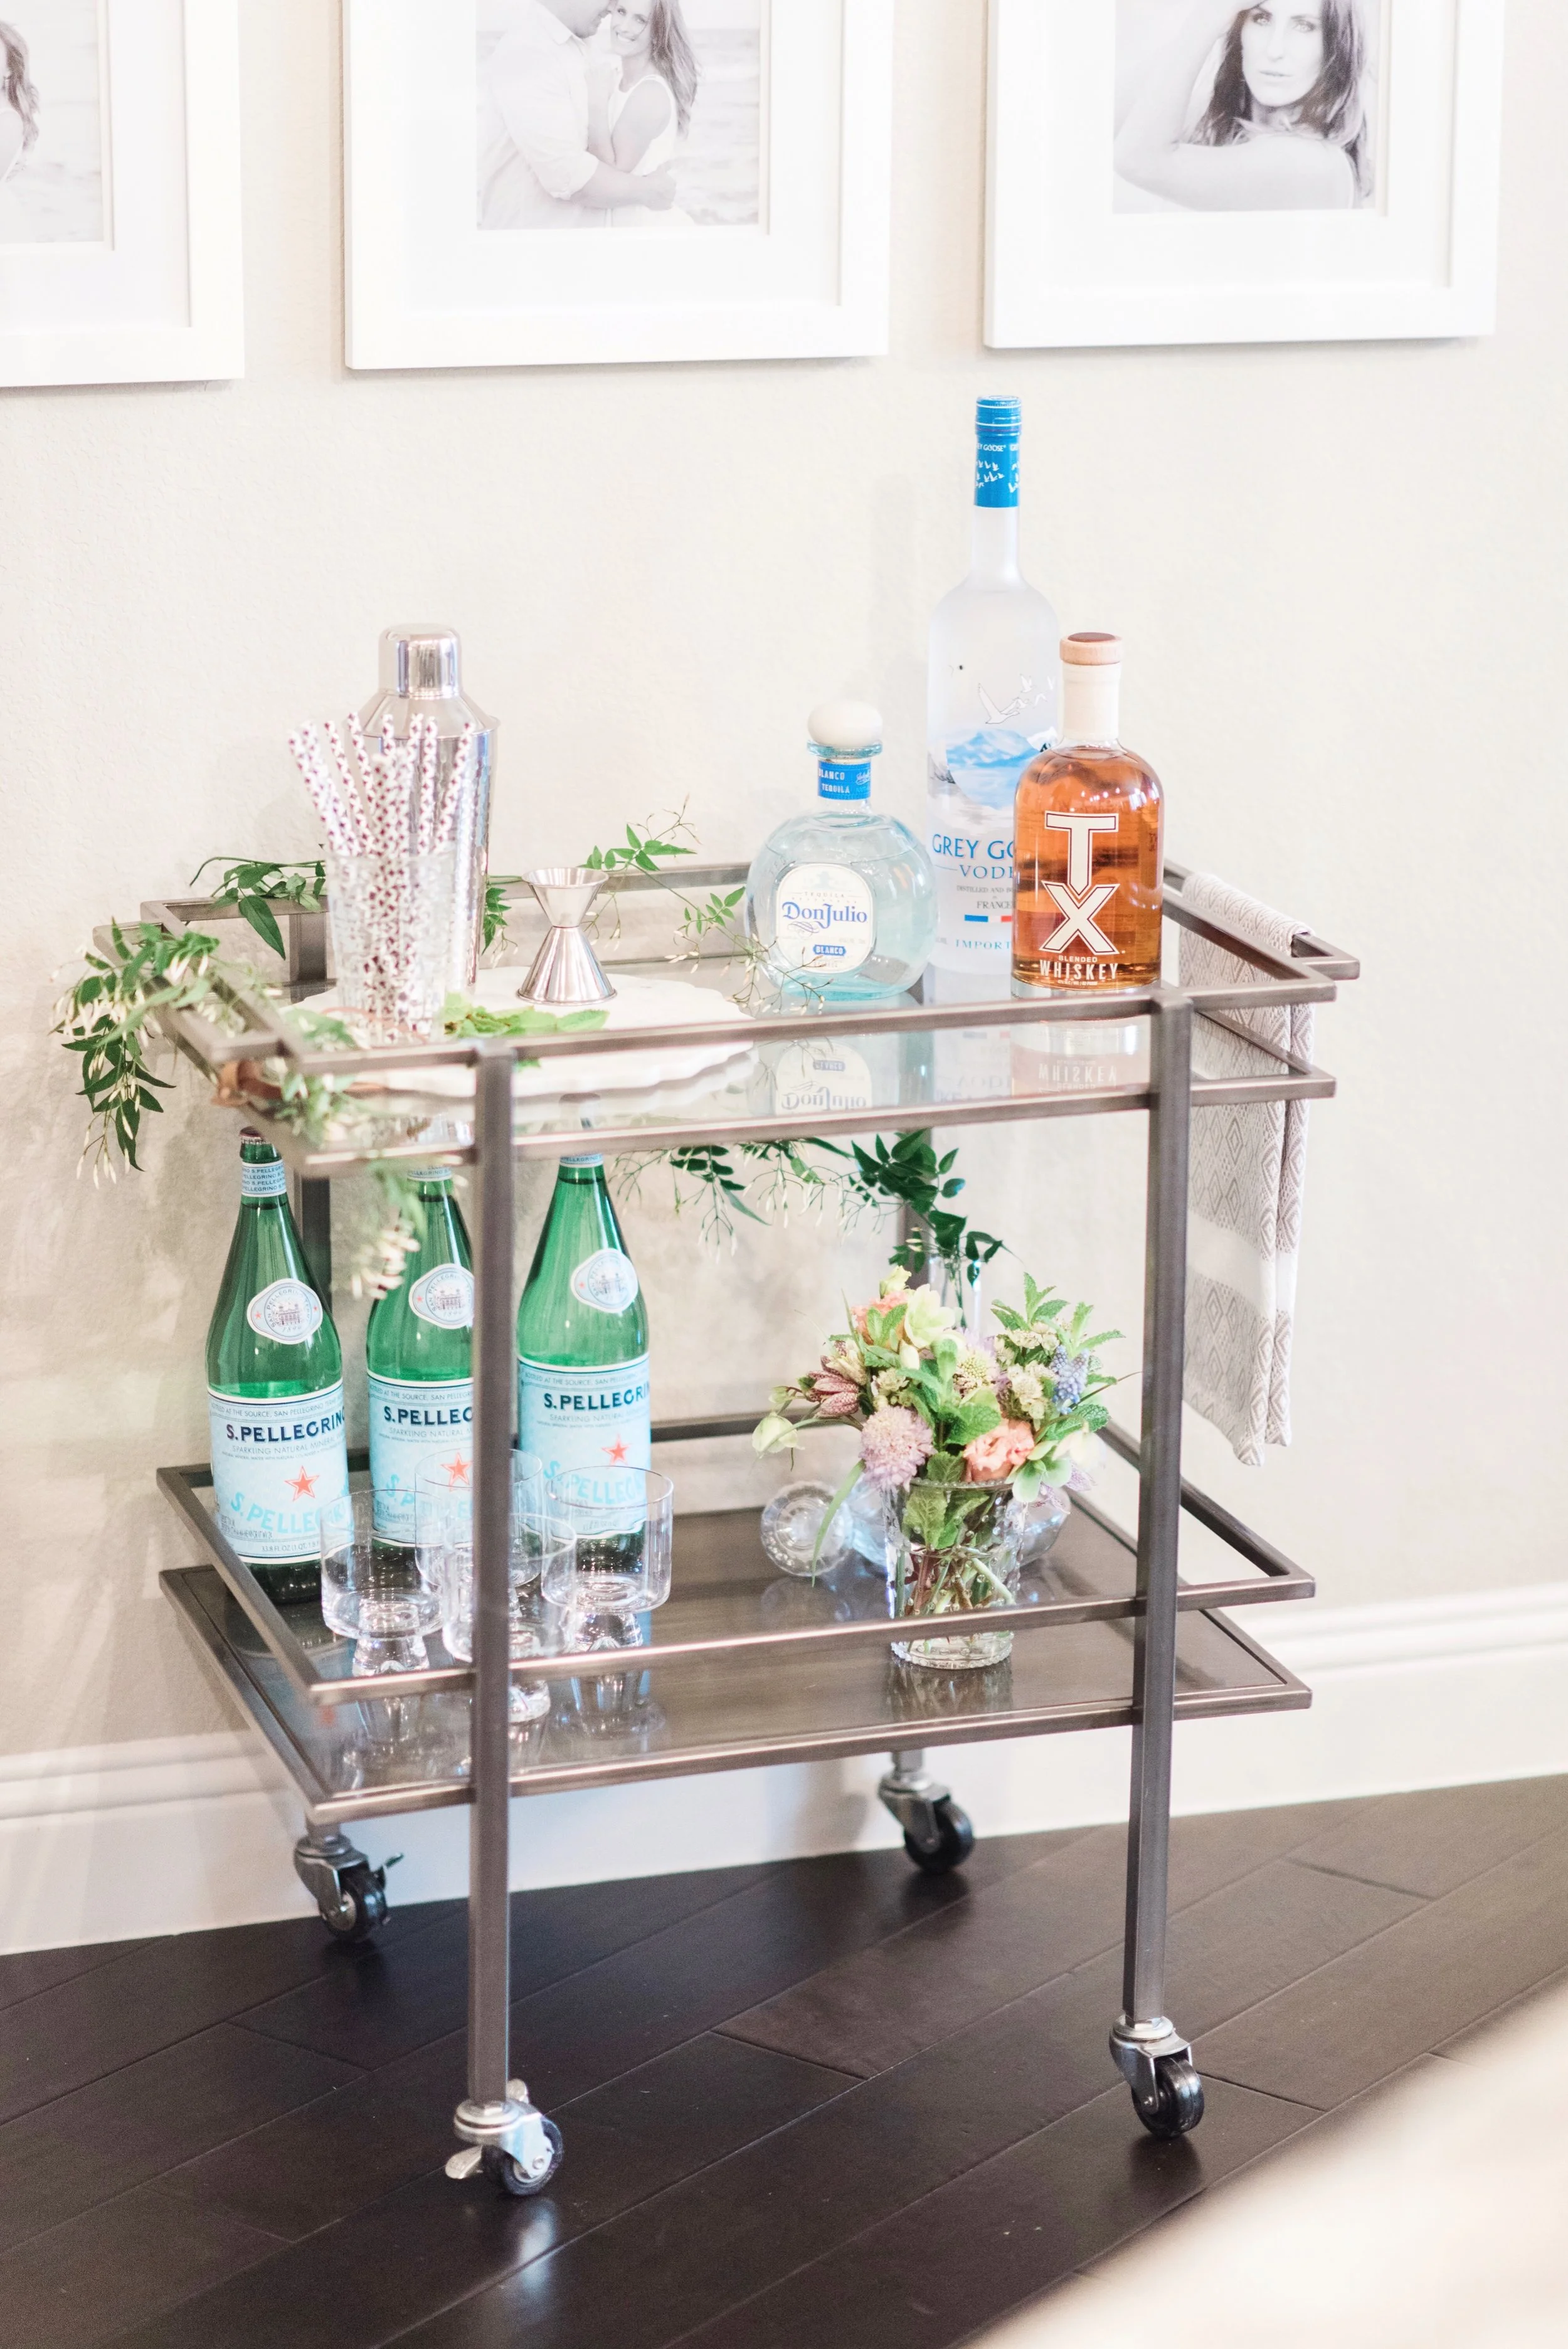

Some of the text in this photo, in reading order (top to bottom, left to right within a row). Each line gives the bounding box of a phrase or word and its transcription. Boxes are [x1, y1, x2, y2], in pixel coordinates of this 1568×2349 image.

[822, 783, 850, 793] TEQUILA
[932, 833, 980, 859] GREY
[956, 885, 988, 893] DISTILLED
[977, 901, 1012, 909] FRANCE
[816, 946, 844, 955] BLANCO
[1039, 959, 1118, 980] WHISKEY
[553, 1376, 563, 1385] THE
[549, 1413, 590, 1423] SPARKLING
[389, 1427, 427, 1438] SPARKLING
[430, 1429, 463, 1438] NATURAL
[233, 1445, 271, 1455] SPARKLING
[275, 1445, 307, 1453] NATURAL
